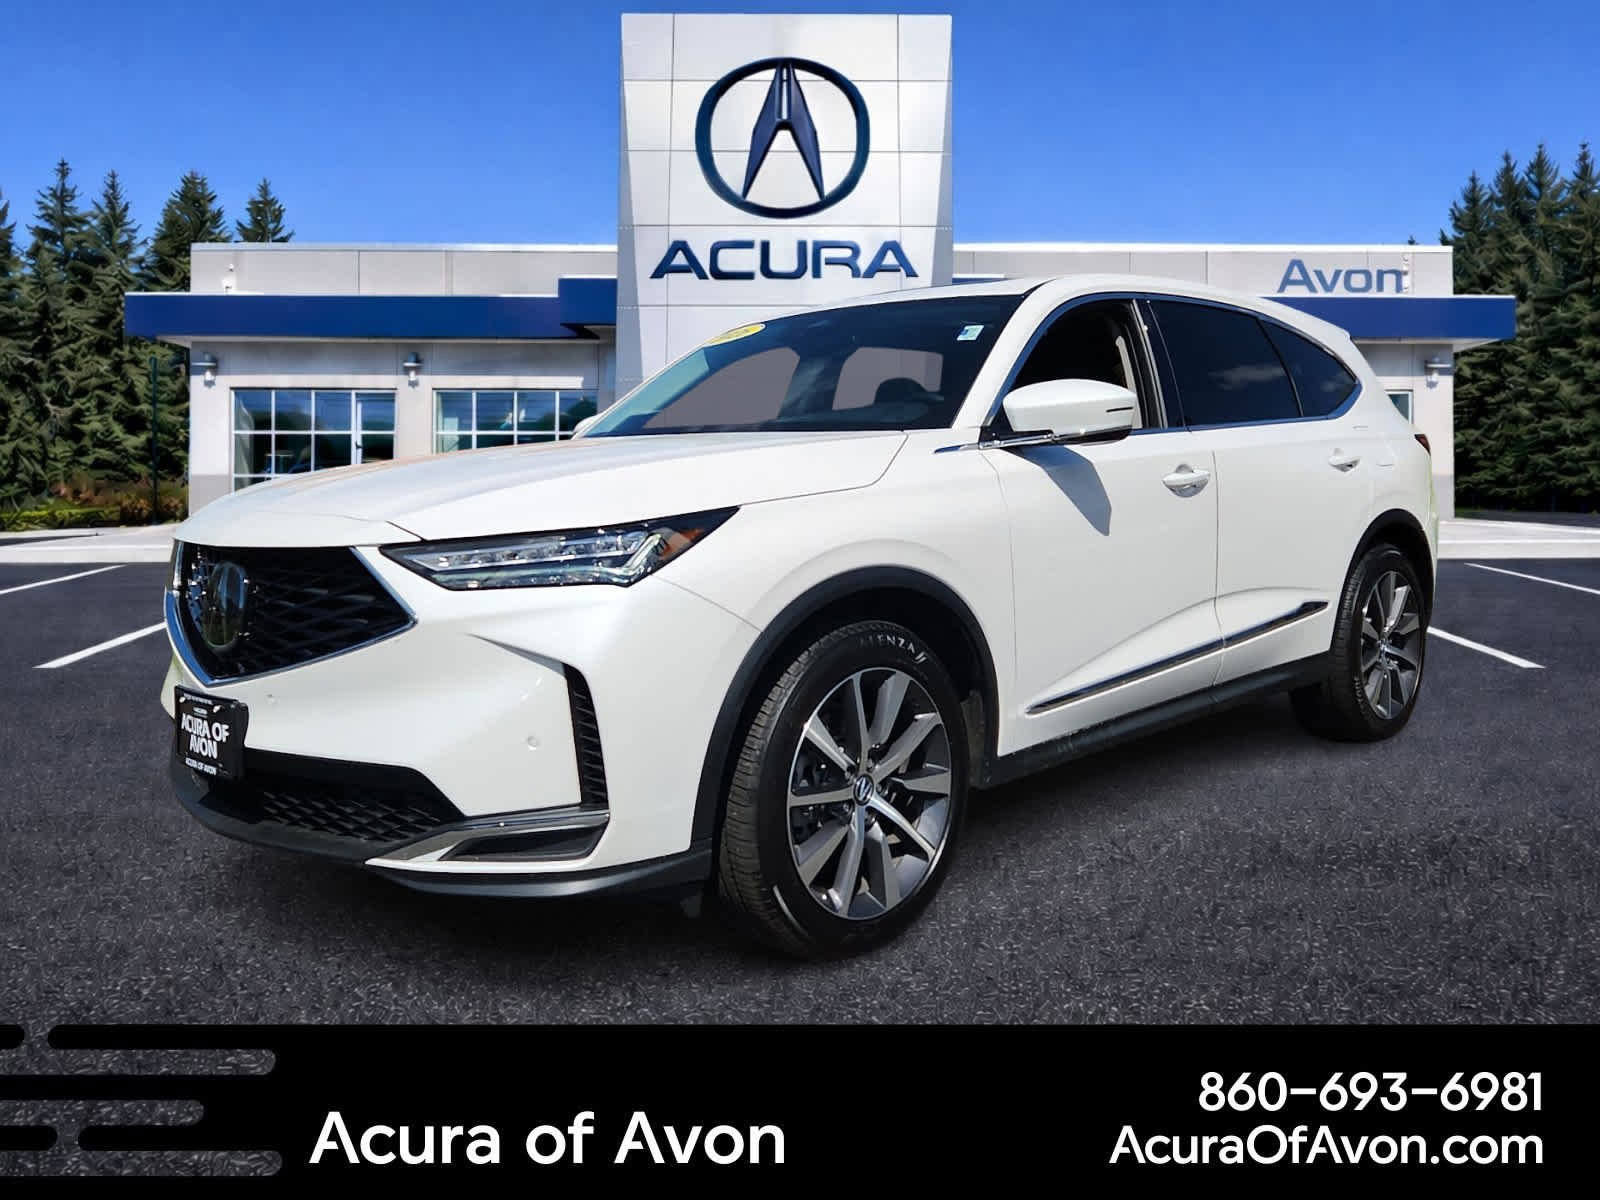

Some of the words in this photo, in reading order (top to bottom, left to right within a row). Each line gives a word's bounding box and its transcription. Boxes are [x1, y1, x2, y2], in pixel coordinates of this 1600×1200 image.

[650, 240, 919, 280] ACURA
[1277, 258, 1404, 294] Avon
[181, 713, 211, 739] ACURA
[212, 722, 230, 743] OF
[189, 735, 218, 759] AVON
